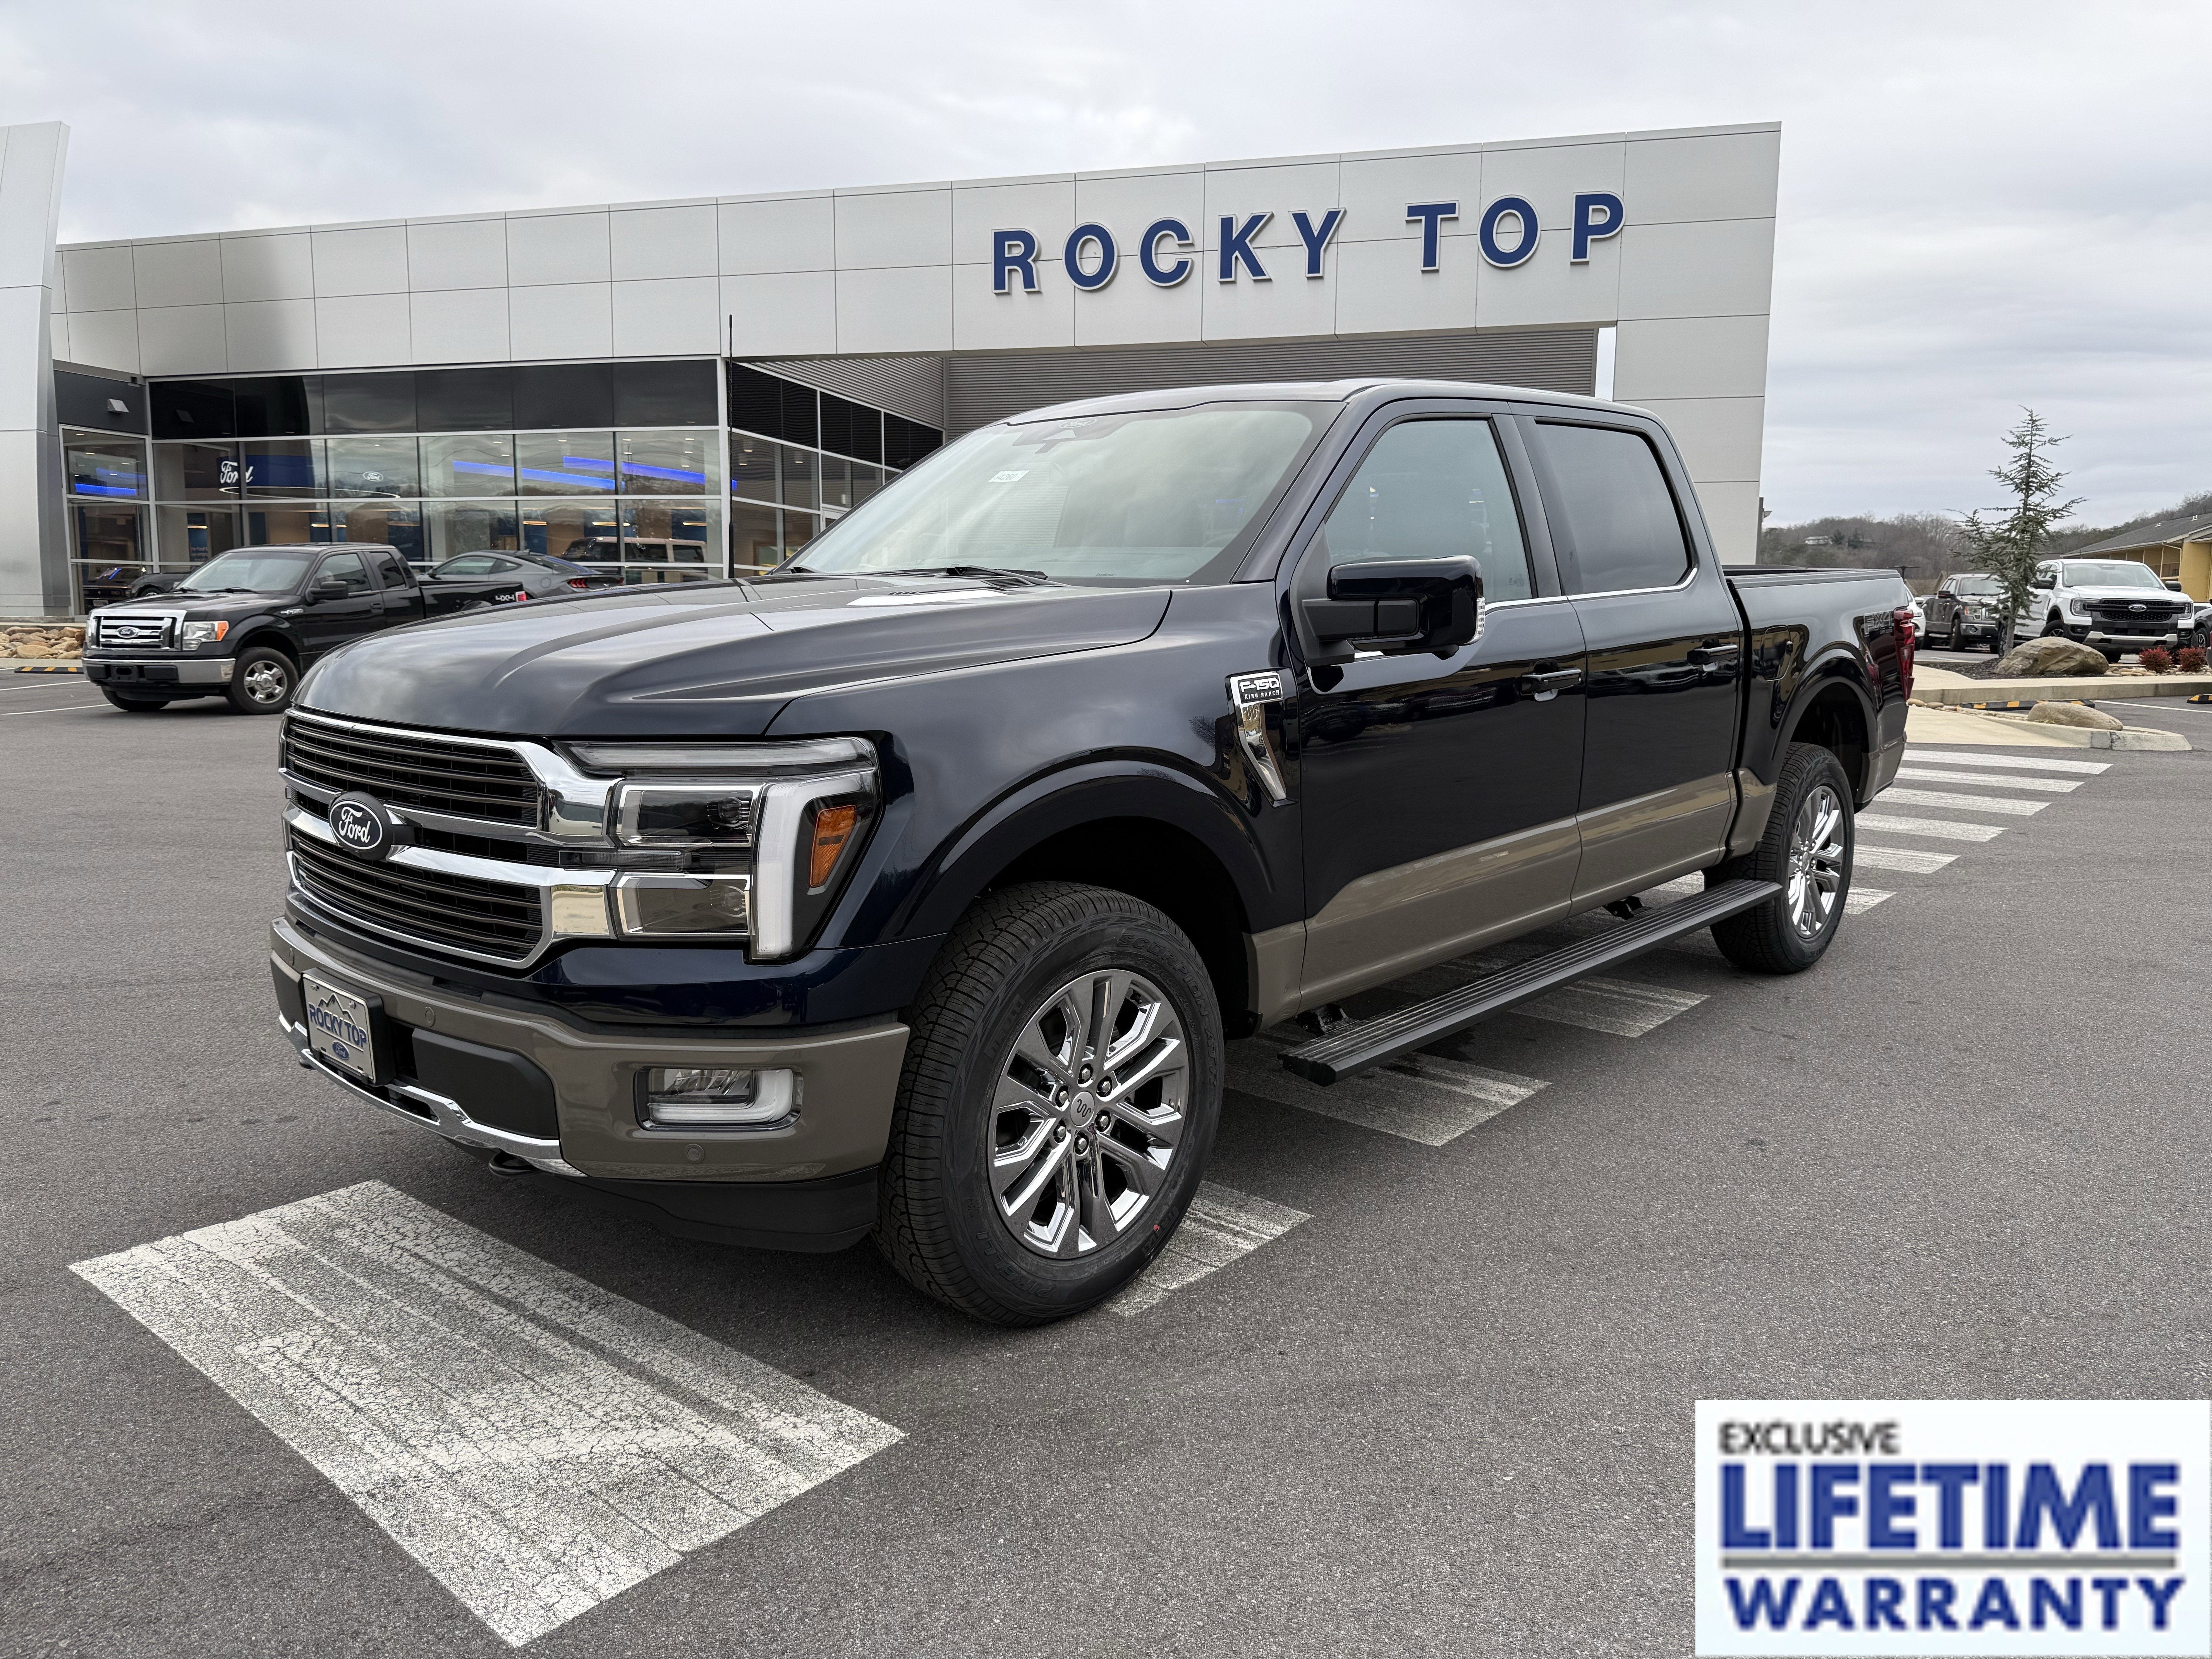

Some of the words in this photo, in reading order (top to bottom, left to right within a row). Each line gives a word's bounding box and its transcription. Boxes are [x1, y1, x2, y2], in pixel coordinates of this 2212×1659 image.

[992, 208, 1345, 293] ROCKY
[1406, 191, 1626, 271] TOP
[1239, 677, 1280, 692] F-150
[1261, 689, 1279, 697] RANCH
[339, 806, 371, 843] Ford
[1117, 933, 1209, 1016] SCORPION
[309, 1002, 343, 1037] ROCKY
[343, 1019, 367, 1048] TOP
[335, 1044, 346, 1057] Ford
[976, 1231, 1056, 1298] PIRELLI
